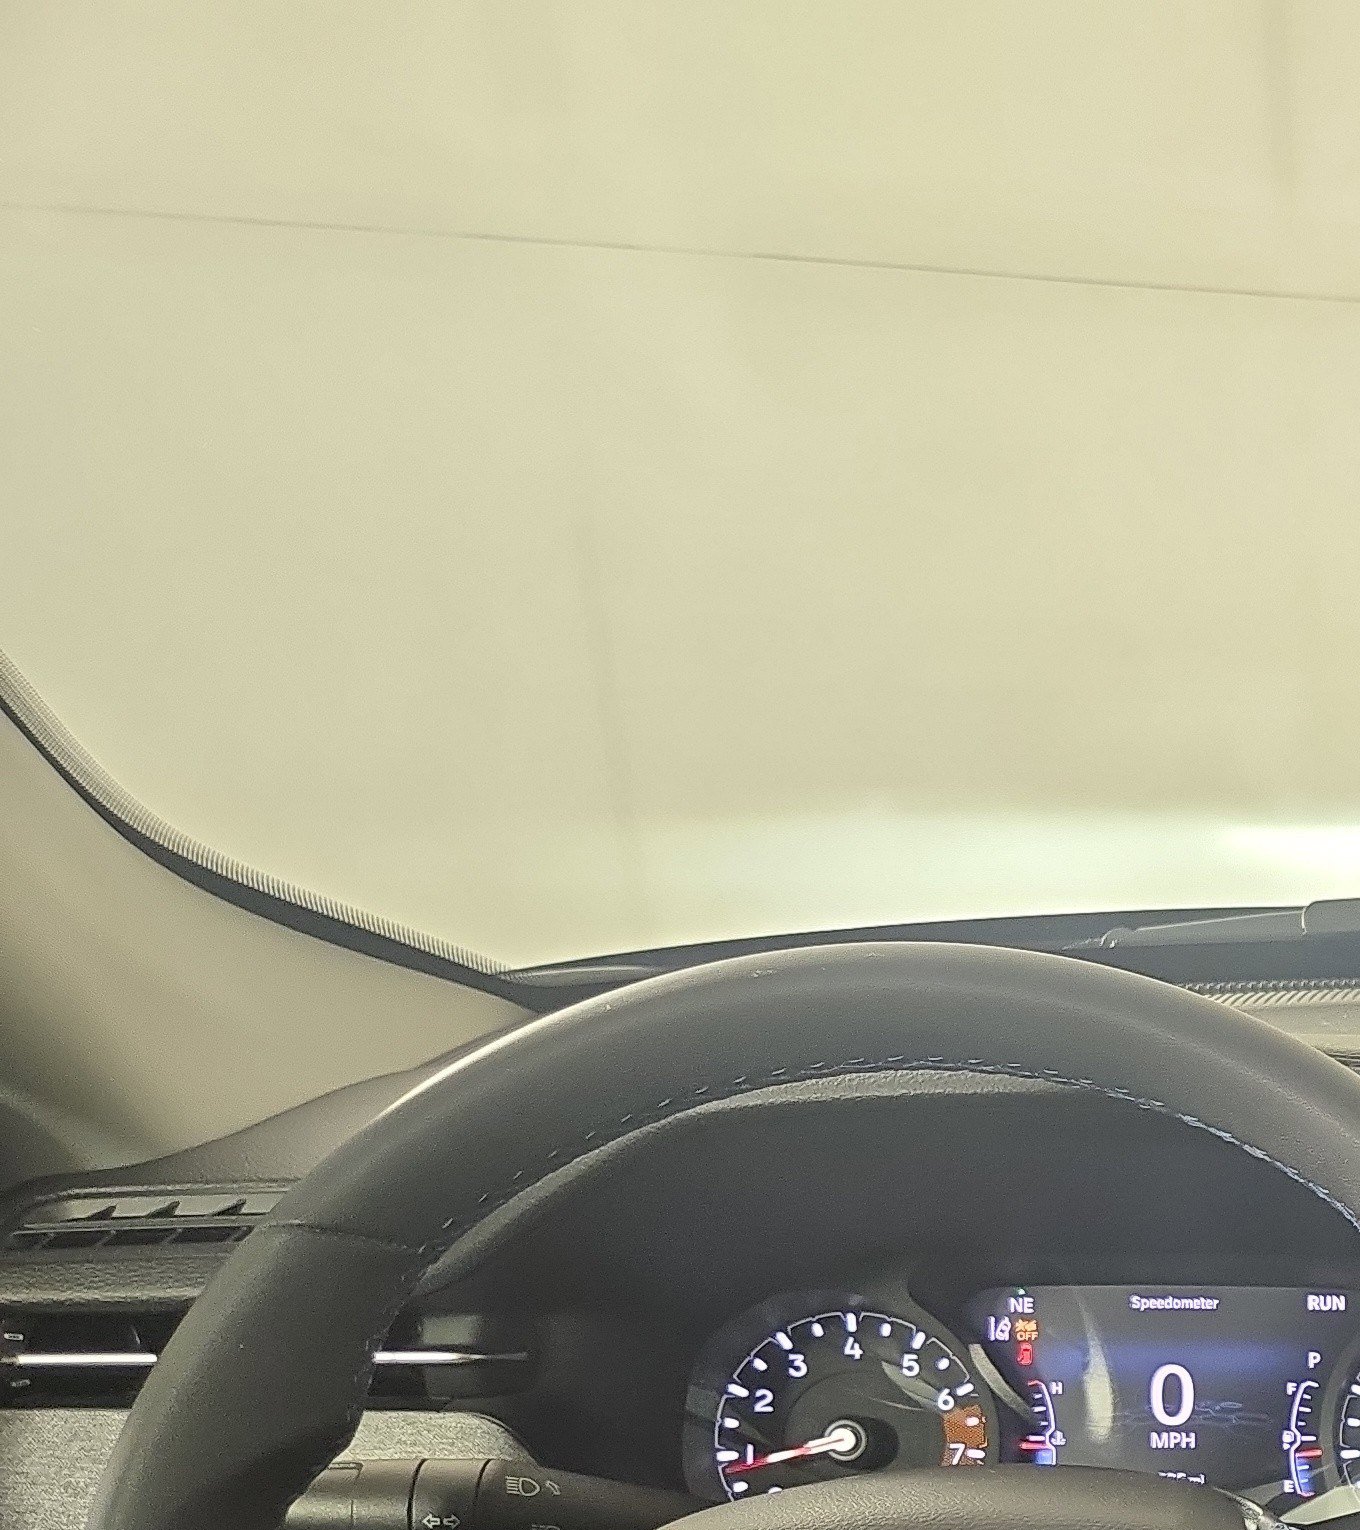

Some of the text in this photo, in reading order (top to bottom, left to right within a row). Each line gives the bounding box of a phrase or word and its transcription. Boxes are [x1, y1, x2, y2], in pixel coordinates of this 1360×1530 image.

[1009, 1297, 1034, 1313] NE
[1130, 1296, 1219, 1311] Speedometer
[1307, 1296, 1346, 1311] RUN
[1016, 1331, 1038, 1342] OFF
[843, 1336, 863, 1360] 4
[788, 1354, 808, 1378] 3
[901, 1354, 920, 1378] 5
[1308, 1353, 1322, 1370] P
[937, 1387, 955, 1409] 6
[1051, 1382, 1063, 1395] H
[1150, 1364, 1196, 1426] 0
[1287, 1383, 1297, 1396] F
[753, 1389, 775, 1413] 2
[1150, 1431, 1196, 1450] MPH
[745, 1444, 755, 1466] 1
[949, 1444, 966, 1466] 7
[1283, 1480, 1295, 1493] E
